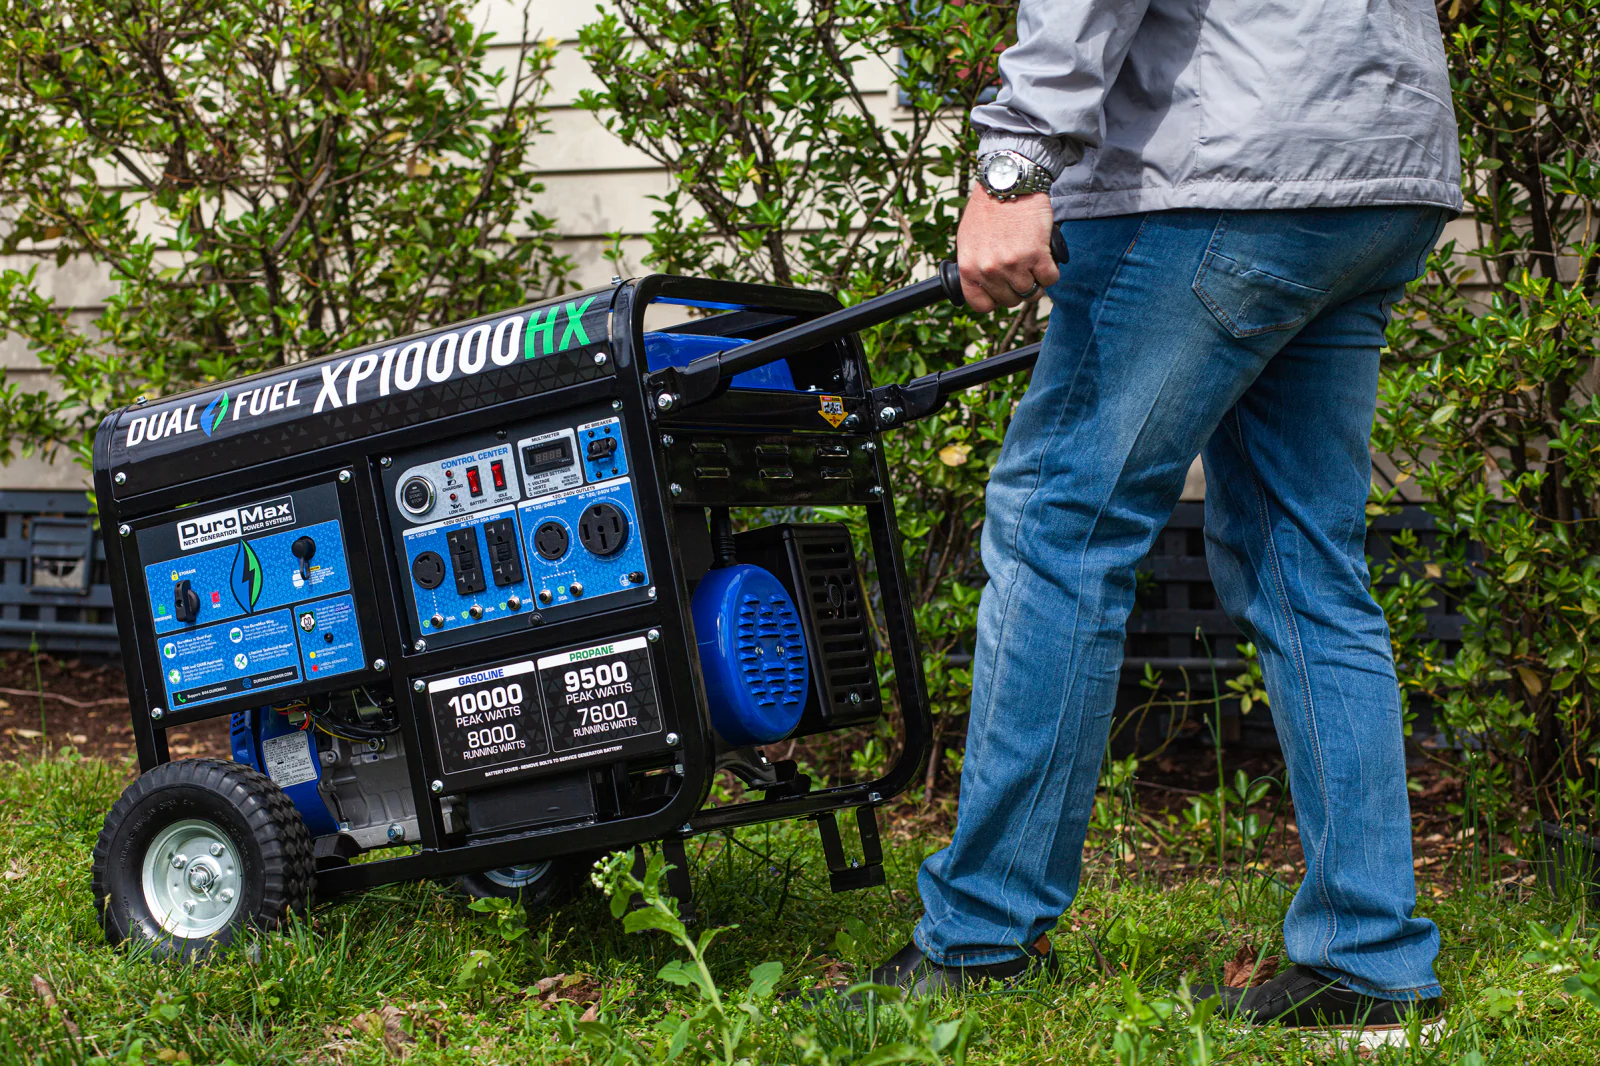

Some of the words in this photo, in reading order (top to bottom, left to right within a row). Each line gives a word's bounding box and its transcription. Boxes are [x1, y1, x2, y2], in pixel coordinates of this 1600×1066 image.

[126, 404, 198, 448] DUAL
[232, 378, 301, 422] FUEL
[313, 296, 597, 414] XP10000HX
[591, 418, 613, 428] BREAKER
[531, 432, 560, 442] MULTIMETER
[441, 455, 477, 470] CONTROL
[478, 447, 509, 460] CENTER
[532, 478, 550, 486] VOLTAGE
[533, 472, 549, 480] METER
[549, 467, 572, 477] SETTINGS
[442, 483, 464, 493] CHARGING
[576, 485, 596, 495] OUTLETS
[469, 498, 488, 507] BATTERY
[494, 496, 514, 504] CONTROL
[443, 518, 455, 526] 120V
[455, 514, 475, 524] OUTLETS
[467, 518, 480, 526] 120V
[183, 537, 199, 546] NEXT
[200, 528, 238, 543] GENERATION
[242, 520, 264, 532] POWER
[265, 515, 293, 527] SYSTEMS
[415, 531, 428, 539] 120V
[569, 645, 614, 662] PROPANE
[458, 668, 505, 686] GASOLINE
[564, 661, 628, 693] 9500
[448, 683, 523, 717] 10000
[565, 690, 595, 706] PEAK
[595, 682, 633, 699] WATTS
[455, 714, 483, 729] PEAK
[484, 705, 521, 723] WATTS
[577, 700, 628, 727] 7600
[467, 723, 517, 749] 8000
[573, 722, 610, 738] RUNNING
[610, 717, 638, 731] WATTS
[462, 744, 499, 760] RUNNING
[499, 739, 526, 753] WATTS
[485, 769, 504, 777] BATTERY
[504, 766, 519, 774] COVER
[521, 761, 539, 770] REMOVE
[539, 759, 553, 767] BOLTS
[559, 754, 578, 762] SERVICE
[578, 749, 603, 758] GENERATOR
[603, 745, 623, 753] BATTERY
